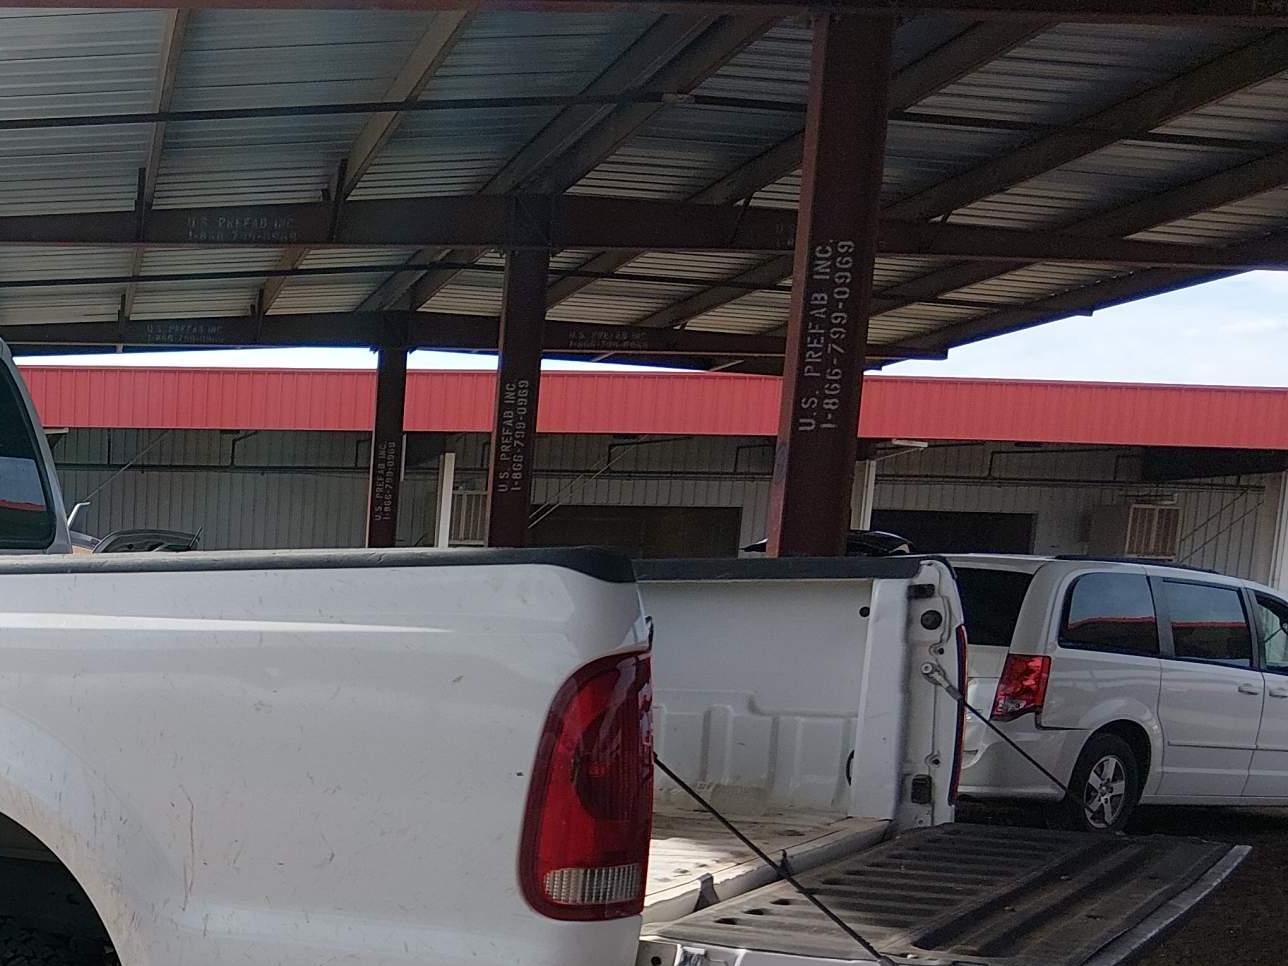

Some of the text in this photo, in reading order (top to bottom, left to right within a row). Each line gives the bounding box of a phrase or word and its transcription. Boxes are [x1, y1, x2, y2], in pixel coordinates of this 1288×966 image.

[798, 239, 833, 431] U.S. PREFAB INC.
[820, 240, 855, 429] 1-866-799-0969
[500, 410, 513, 461] PREFAB
